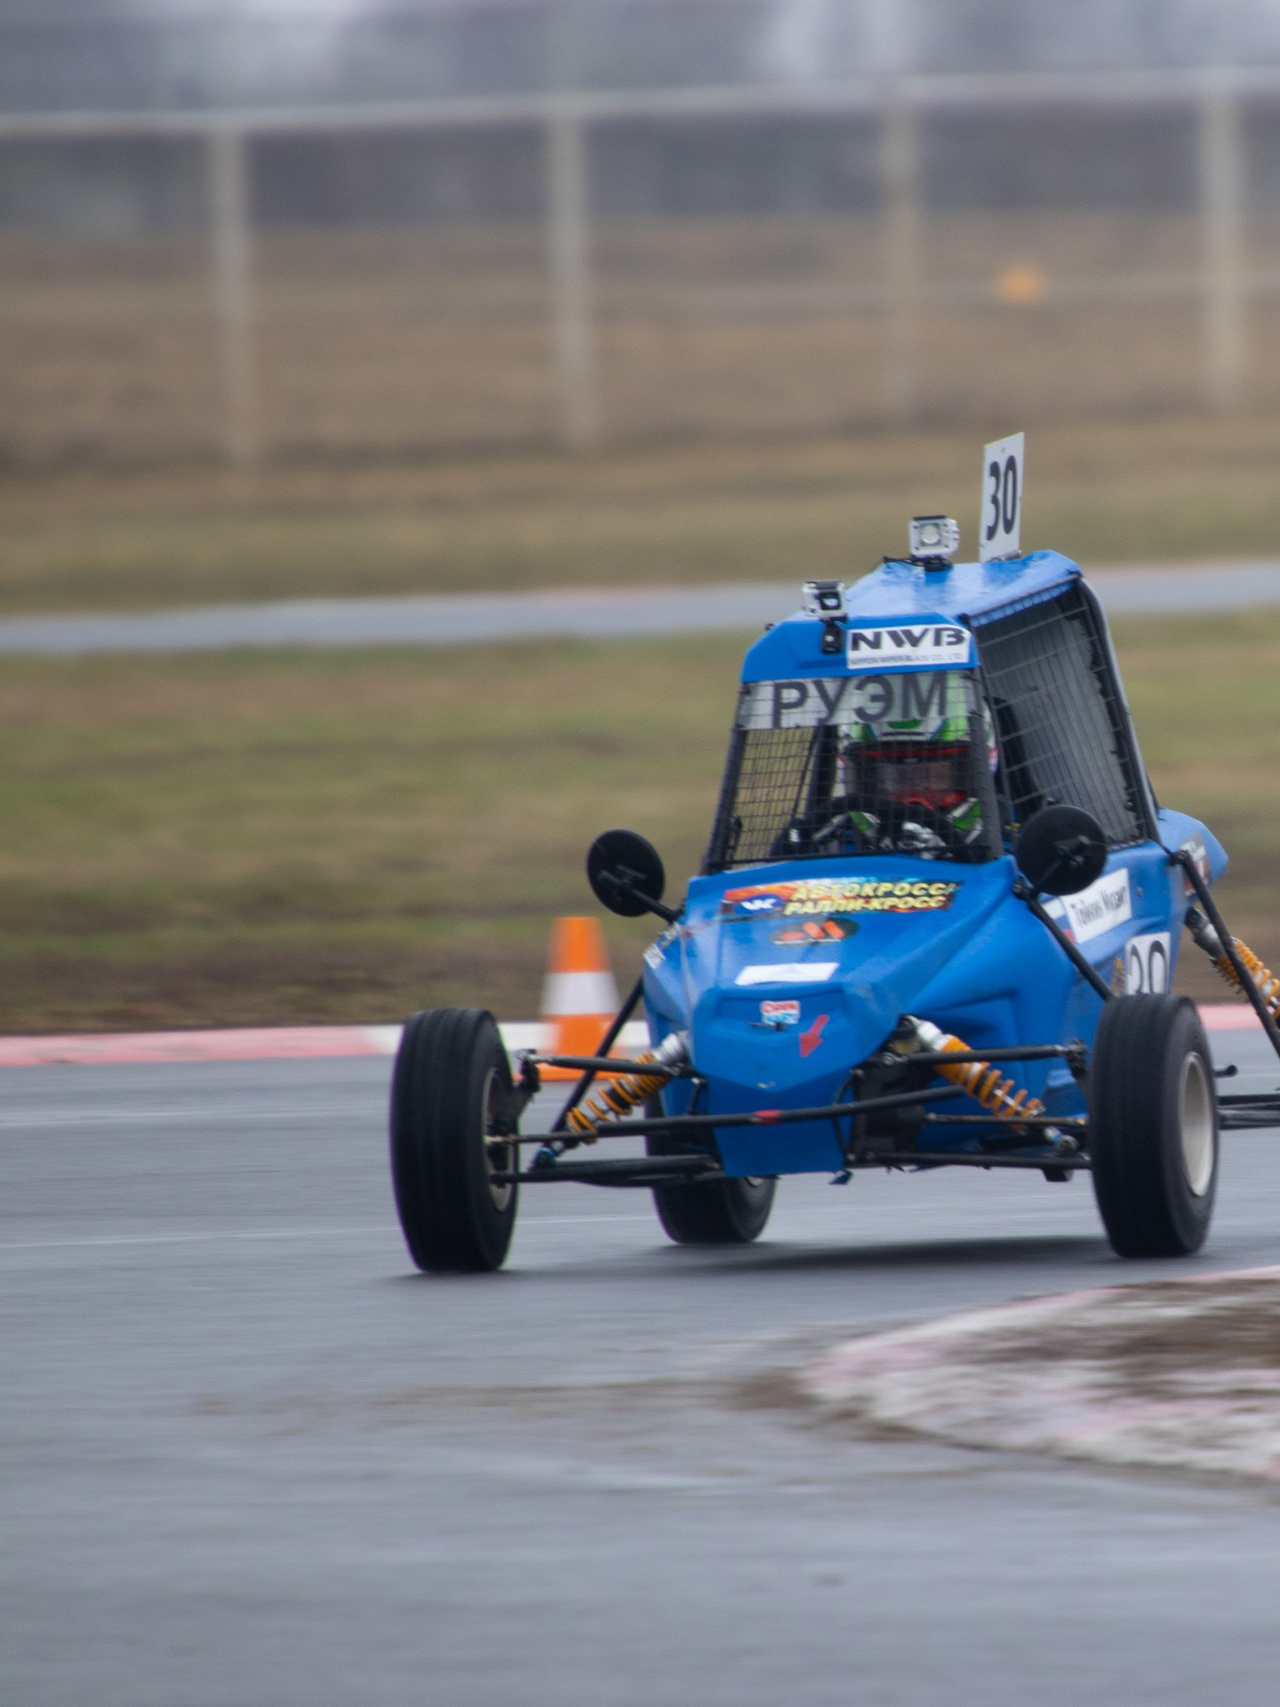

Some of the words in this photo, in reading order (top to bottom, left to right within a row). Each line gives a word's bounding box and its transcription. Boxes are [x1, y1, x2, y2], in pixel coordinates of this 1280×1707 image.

[986, 454, 1018, 541] 30
[850, 627, 967, 652] NWB
[772, 672, 947, 729] РУЭМ
